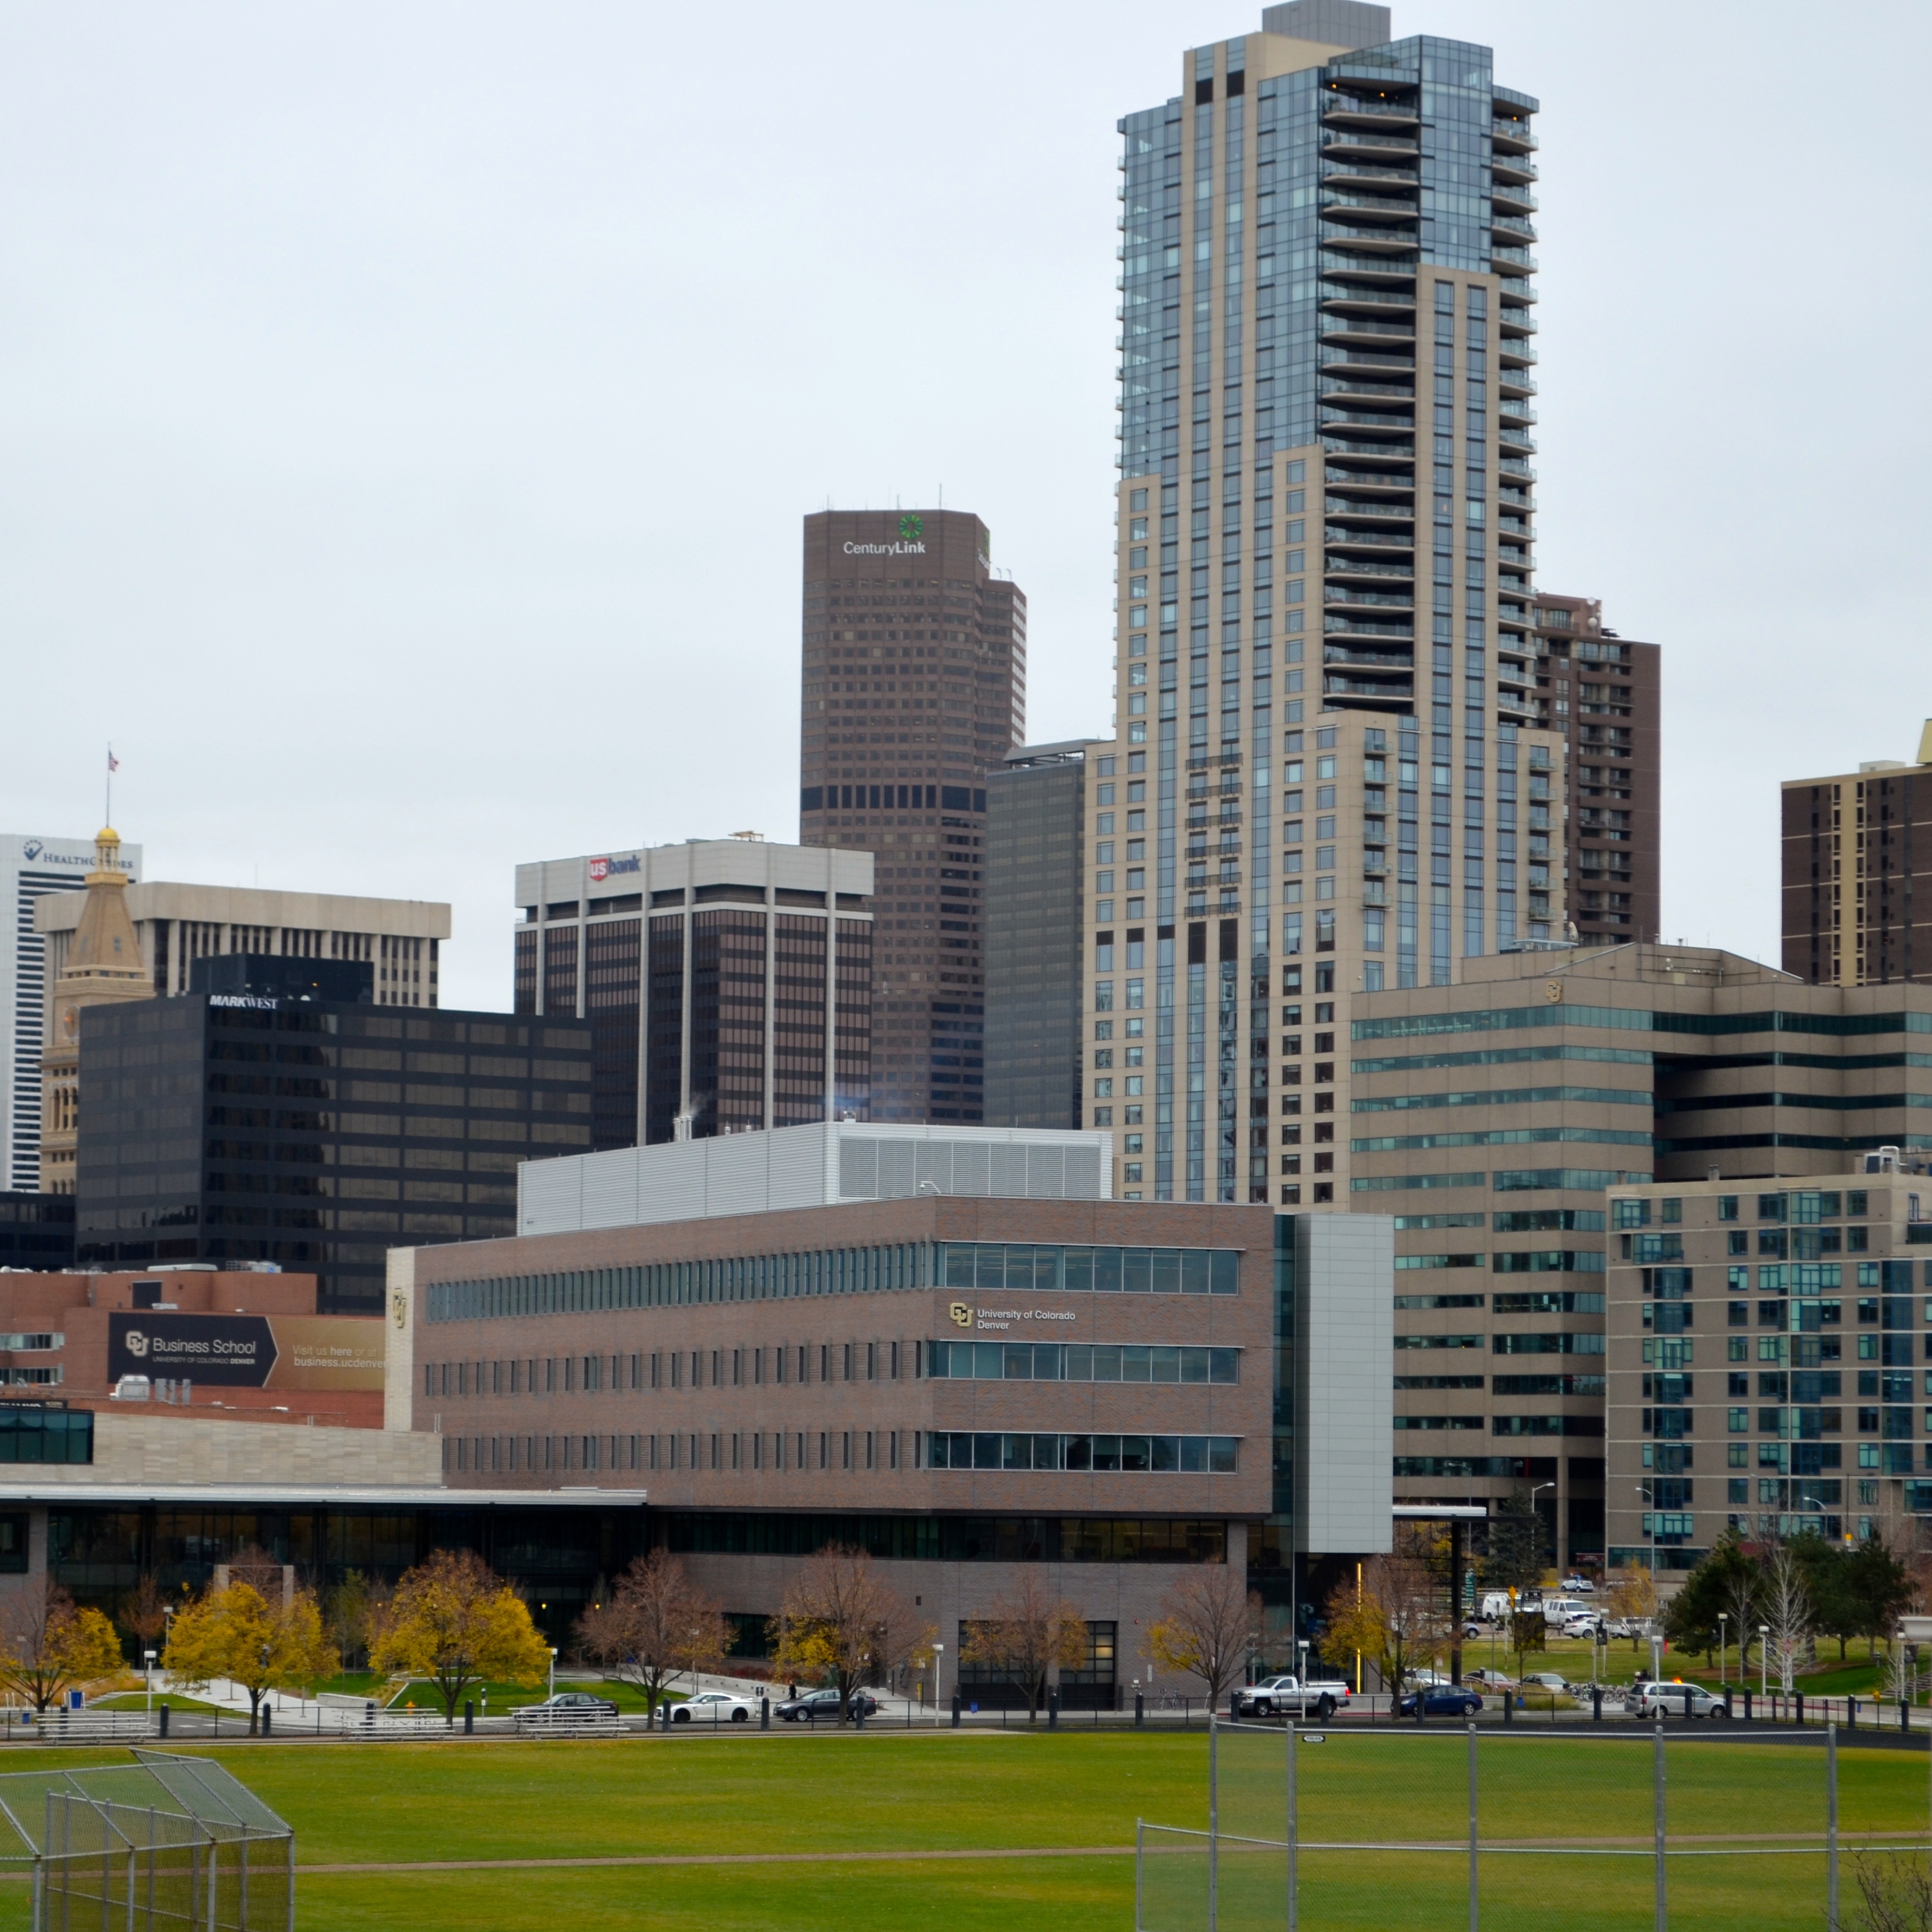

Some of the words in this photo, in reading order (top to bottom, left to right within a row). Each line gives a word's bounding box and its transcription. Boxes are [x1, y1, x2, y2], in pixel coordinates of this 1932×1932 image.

[843, 541, 926, 556] CenturyLink
[209, 995, 278, 1009] MARKWEST
[950, 1302, 973, 1328] CU
[977, 1309, 1022, 1321] University
[1024, 1310, 1033, 1319] of
[1035, 1310, 1076, 1321] Colorado
[977, 1321, 1009, 1330] Denver
[125, 1330, 149, 1357] CU
[153, 1338, 210, 1353] Business
[213, 1339, 256, 1354] School
[292, 1345, 313, 1355] Visit
[316, 1348, 327, 1356] us
[330, 1346, 352, 1356] here
[368, 1348, 377, 1357] at
